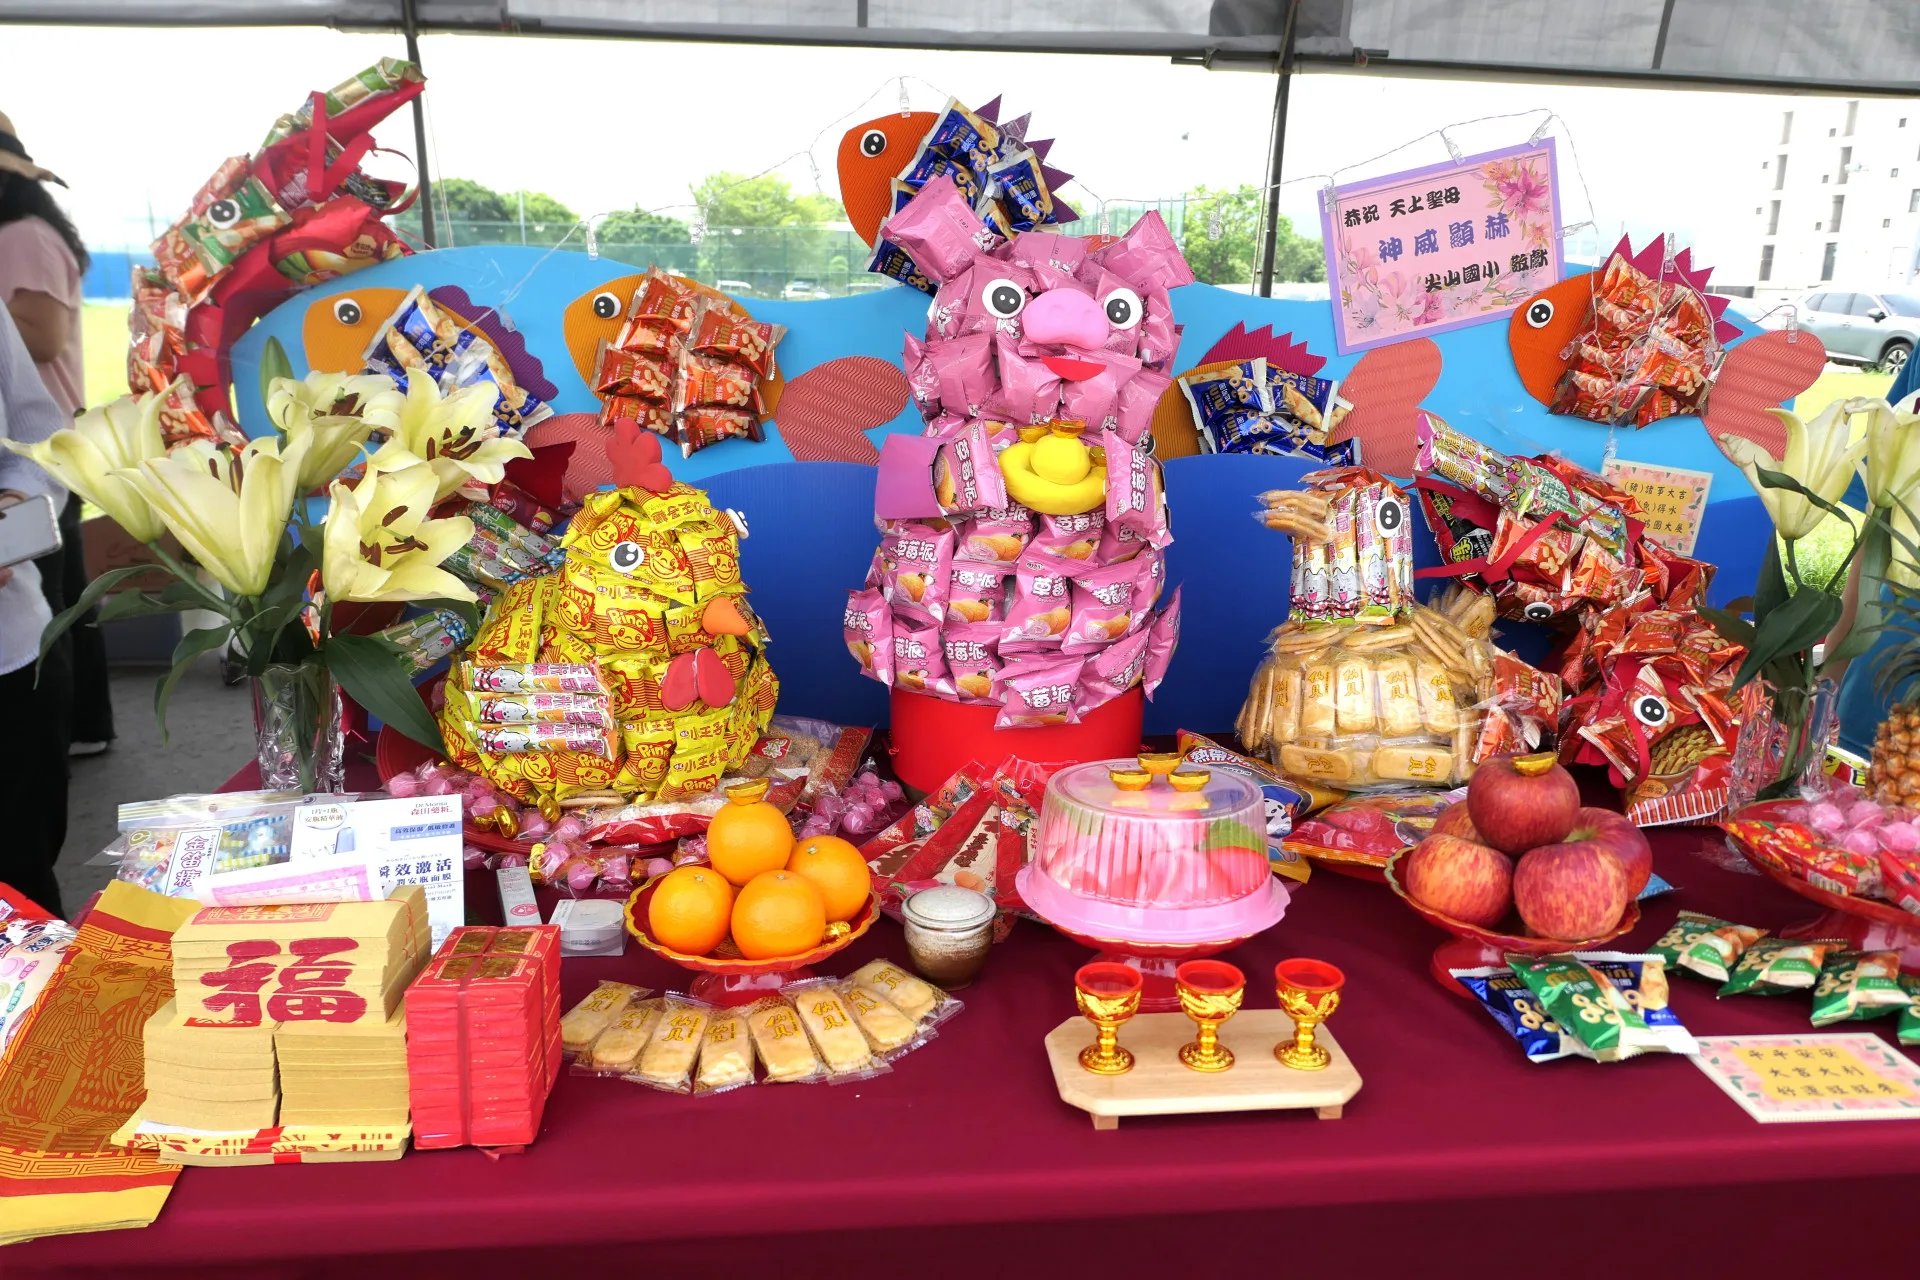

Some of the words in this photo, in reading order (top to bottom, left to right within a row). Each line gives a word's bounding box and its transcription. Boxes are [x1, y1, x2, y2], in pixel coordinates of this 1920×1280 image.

[1345, 204, 1379, 227] 恭祝
[1389, 186, 1461, 218] 天上聖母
[1378, 212, 1510, 263] 神威顯赫
[1424, 261, 1500, 293] 尖山國小
[1510, 249, 1548, 273] 敬獻
[610, 610, 651, 632] Prince
[578, 754, 616, 771] Prince
[684, 748, 729, 772] 小王子麵
[200, 936, 368, 1024] 福
[1749, 1048, 1838, 1060] 平平安安
[1769, 1065, 1865, 1078] 大吉大利
[1776, 1082, 1900, 1097] 好運旺旺來
